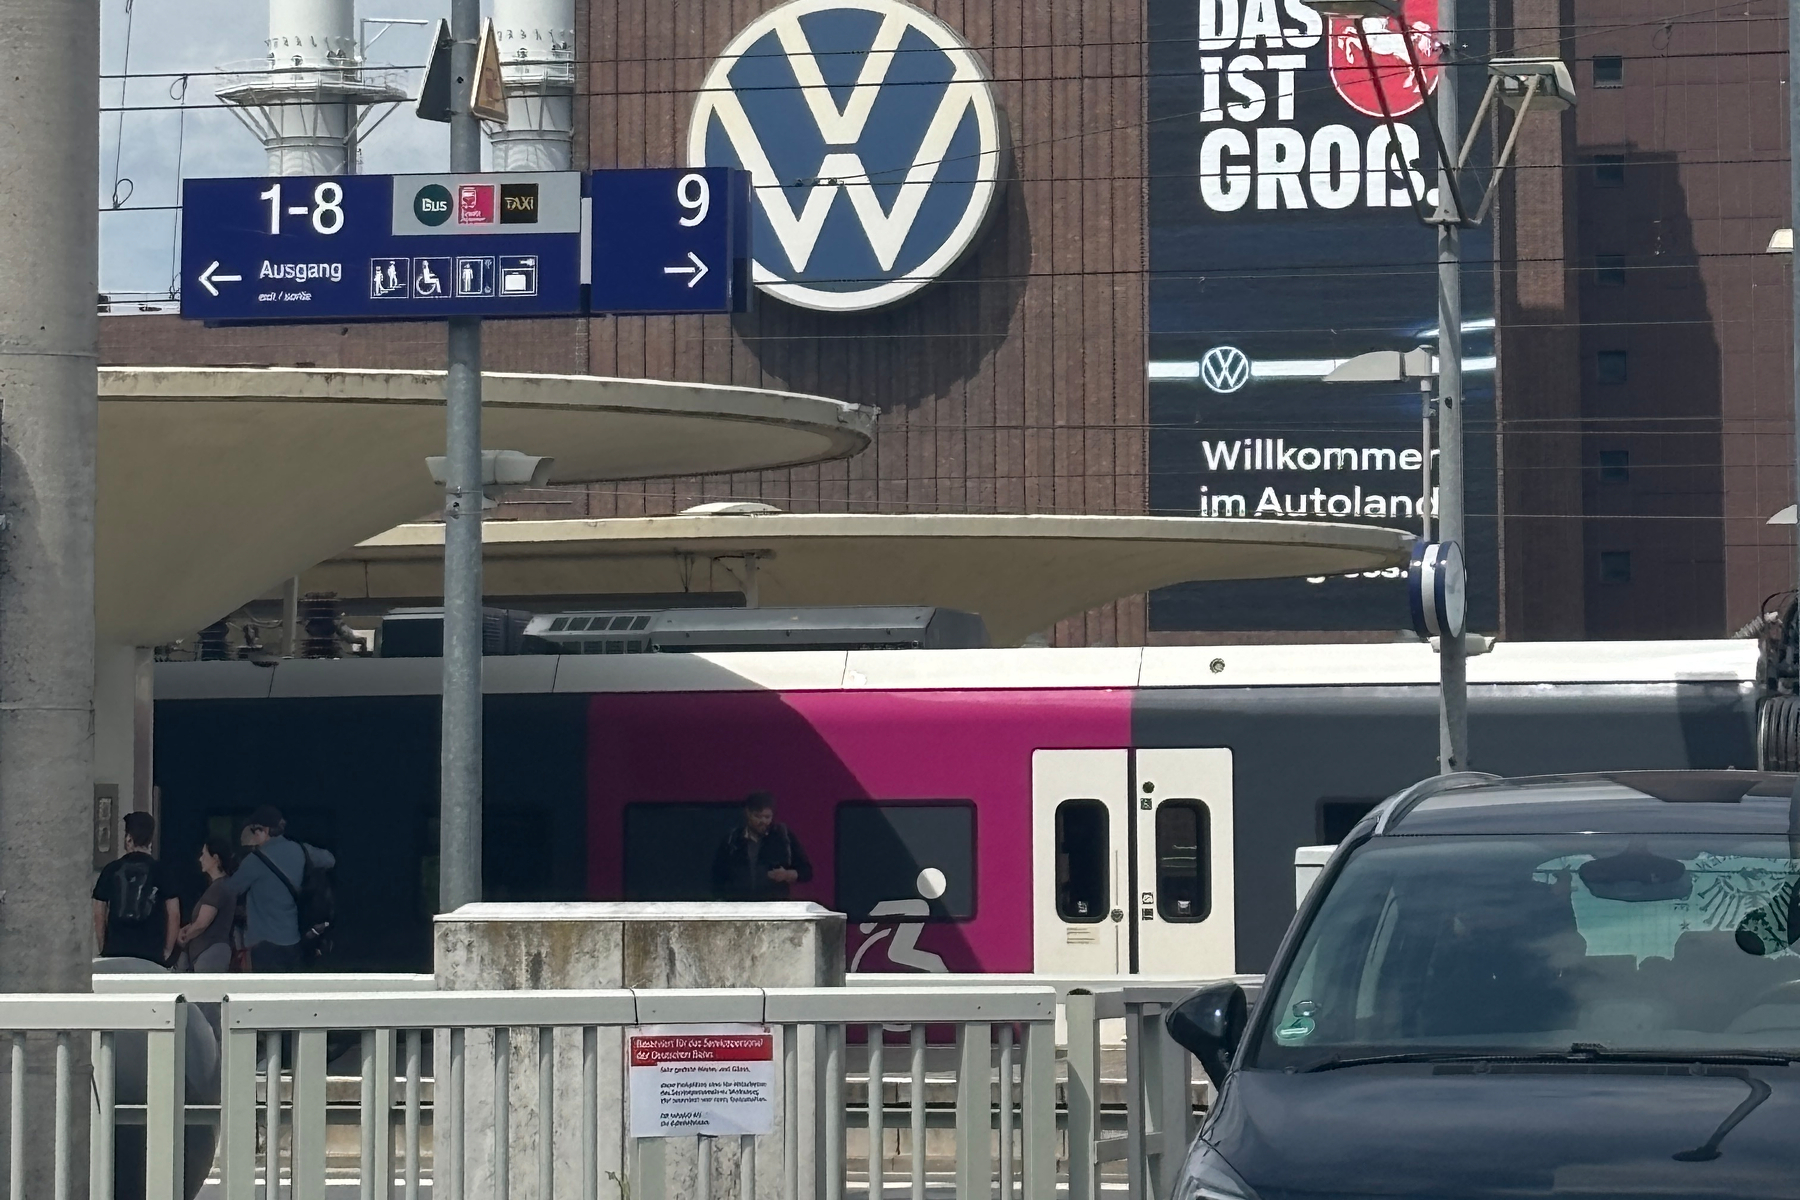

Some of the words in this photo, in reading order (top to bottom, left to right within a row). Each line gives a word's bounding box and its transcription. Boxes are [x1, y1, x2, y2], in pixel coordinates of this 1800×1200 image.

[1200, 54, 1307, 123] IST
[261, 182, 345, 235] 1-8
[422, 198, 448, 212] Bus
[677, 173, 710, 227] 9
[259, 260, 342, 282] Ausgang
[1200, 485, 1246, 517] im
[1253, 485, 1440, 519] Autoland
